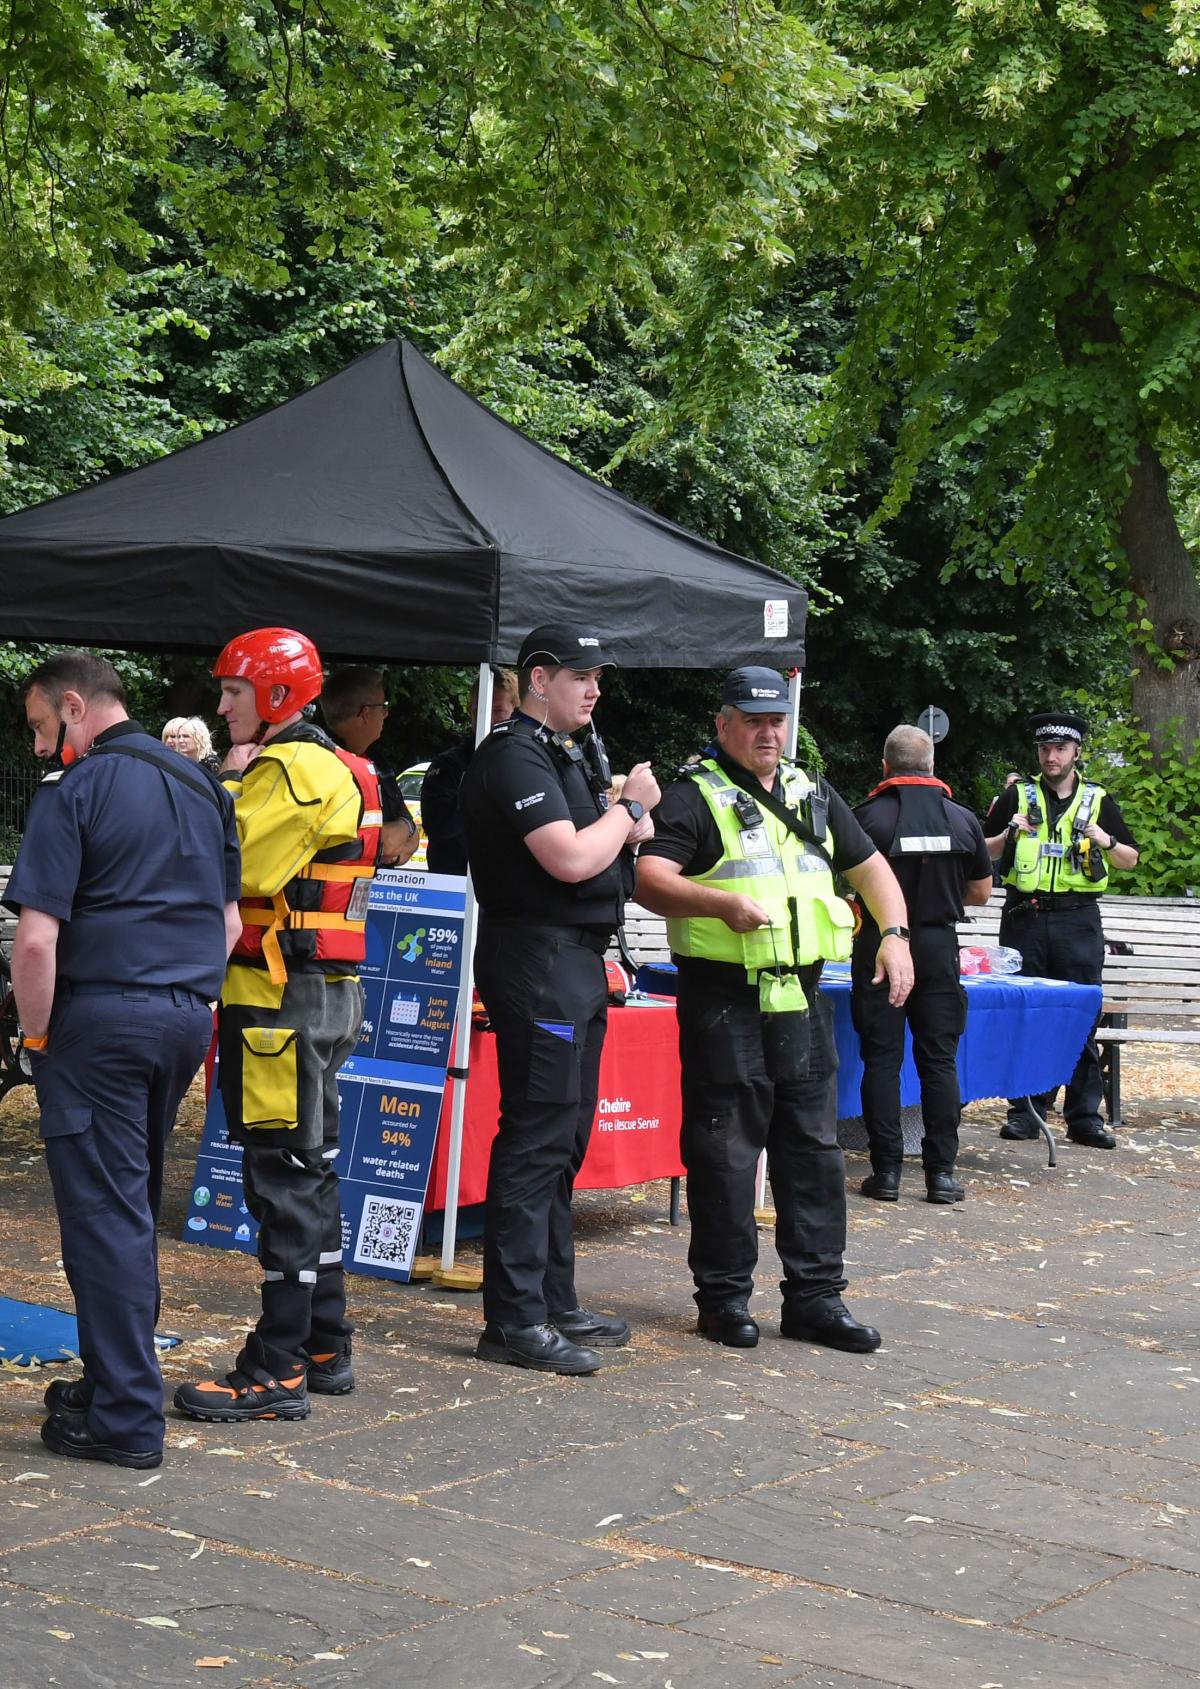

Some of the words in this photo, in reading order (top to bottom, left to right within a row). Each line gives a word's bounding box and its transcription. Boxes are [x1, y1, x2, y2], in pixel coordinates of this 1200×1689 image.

[376, 872, 426, 885] ormation
[369, 890, 384, 900] oss
[386, 890, 403, 901] the
[404, 892, 419, 903] UK
[427, 927, 458, 944] 59%
[425, 957, 453, 969] inland
[427, 996, 449, 1007] June
[427, 1007, 445, 1019] July
[420, 1018, 450, 1030] August
[386, 1029, 411, 1038] Historically
[431, 1034, 444, 1042] most
[391, 1036, 411, 1044] common
[412, 1037, 430, 1046] months
[388, 1042, 414, 1050] accidental
[414, 1044, 440, 1054] drownings
[379, 1094, 421, 1118] Men
[599, 1096, 631, 1114] Chehire
[382, 1119, 409, 1128] accounted
[598, 1119, 614, 1132] Fire
[381, 1129, 412, 1147] 94%
[210, 1140, 229, 1150] rescue
[229, 1143, 244, 1152] from
[362, 1156, 388, 1167] water
[389, 1159, 420, 1172] related
[210, 1167, 231, 1175] Cheshire
[376, 1167, 405, 1180] deaths
[216, 1192, 232, 1201] Open
[215, 1199, 233, 1208] Water
[209, 1222, 232, 1233] Vehicles
